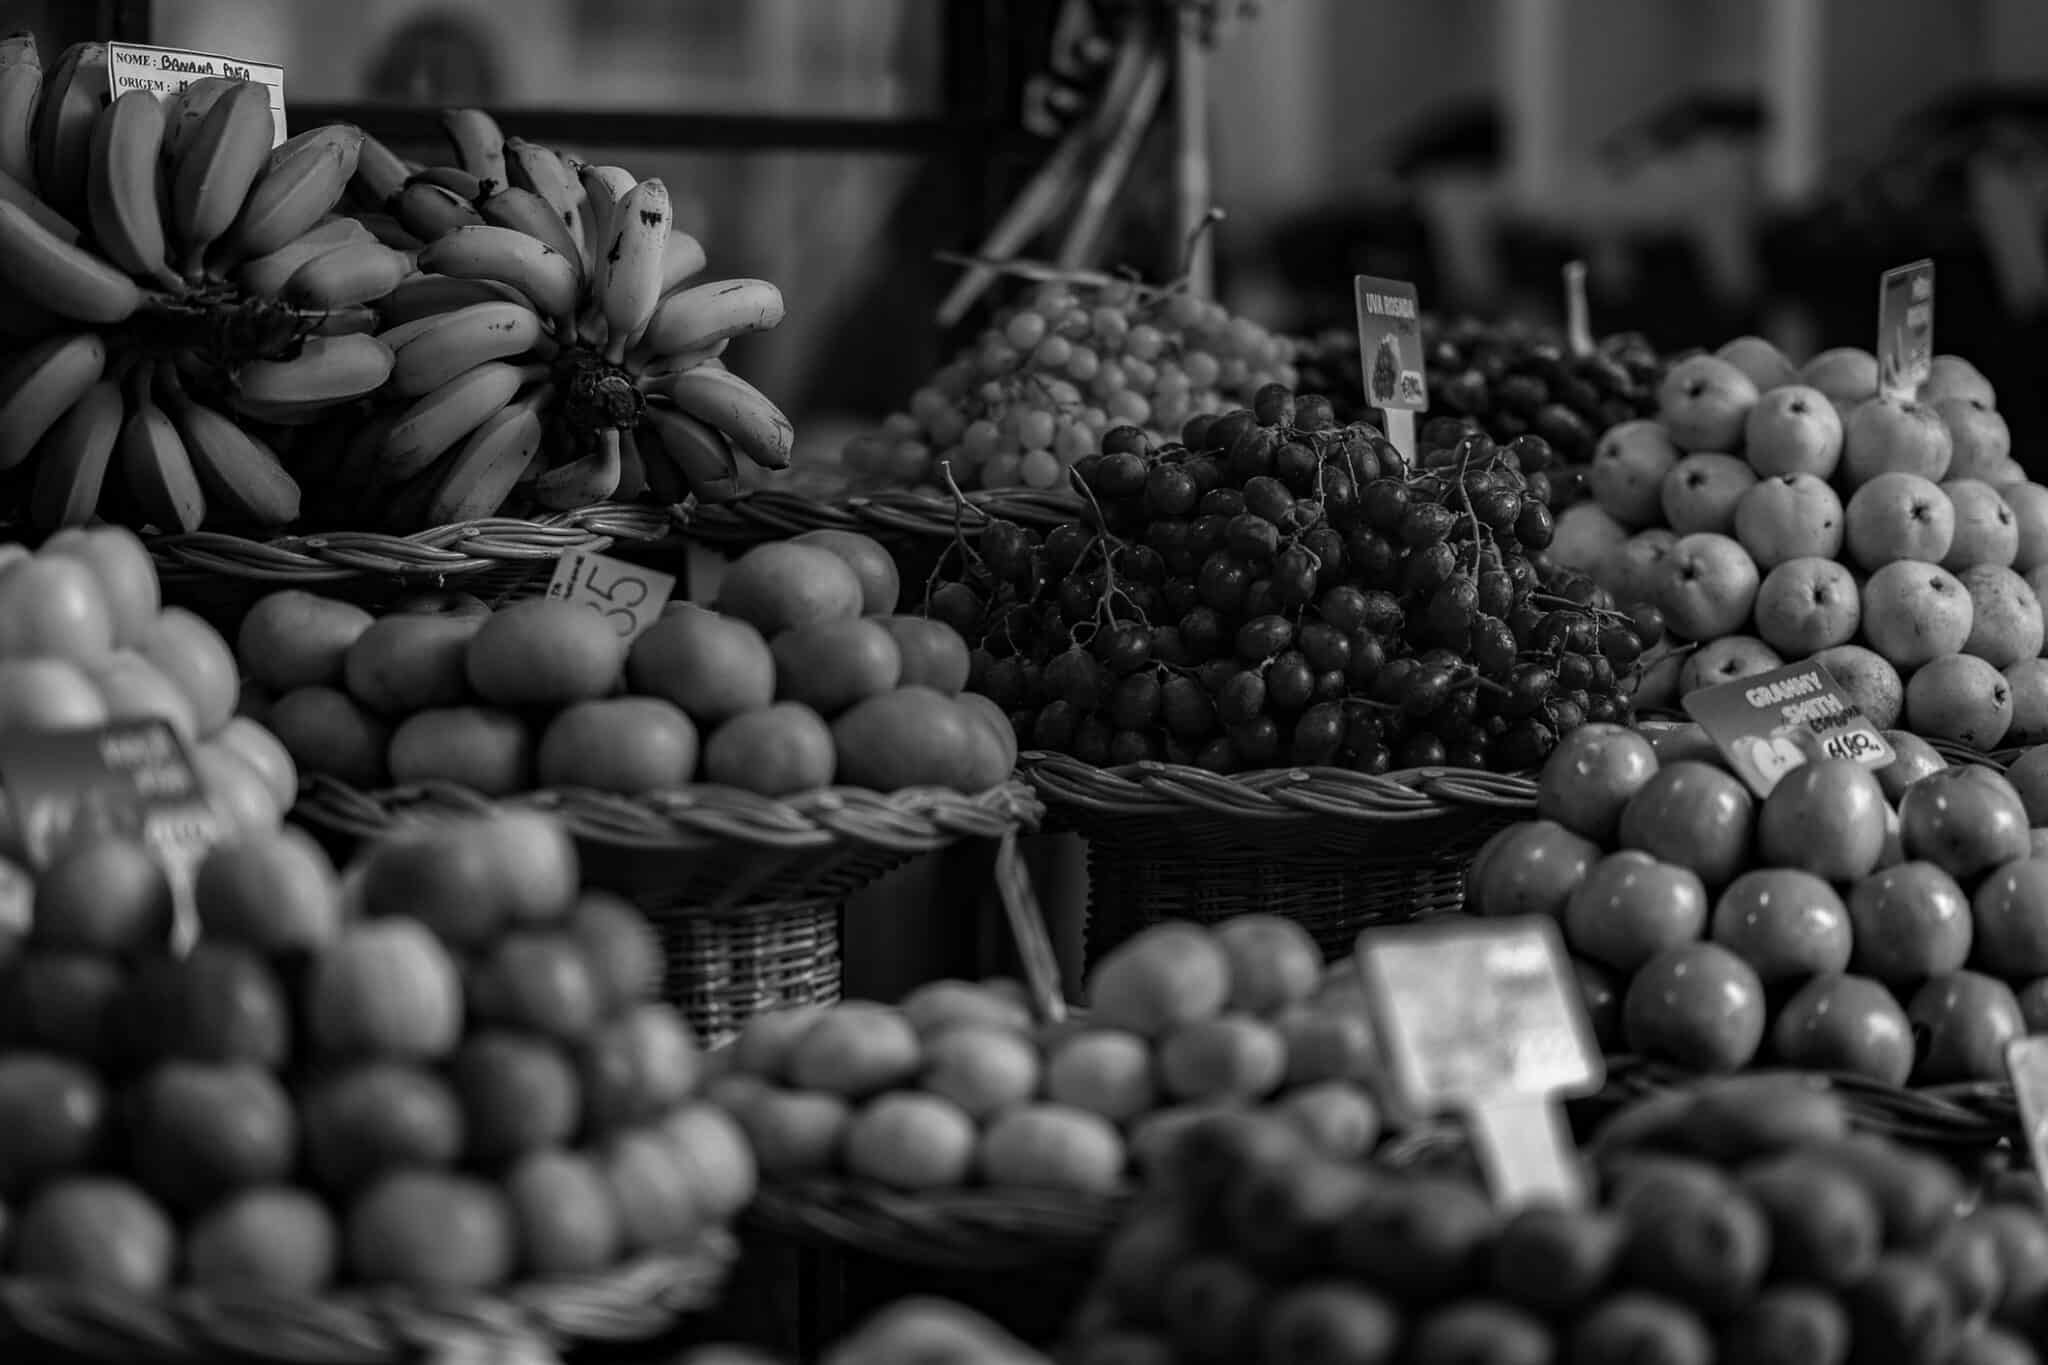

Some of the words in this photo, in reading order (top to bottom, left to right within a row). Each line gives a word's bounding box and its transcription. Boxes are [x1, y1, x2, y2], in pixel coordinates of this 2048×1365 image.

[161, 54, 214, 75] BANANA
[1365, 292, 1384, 315] UVA
[1744, 671, 1823, 708] GRANNY
[1781, 692, 1844, 725] SMITH
